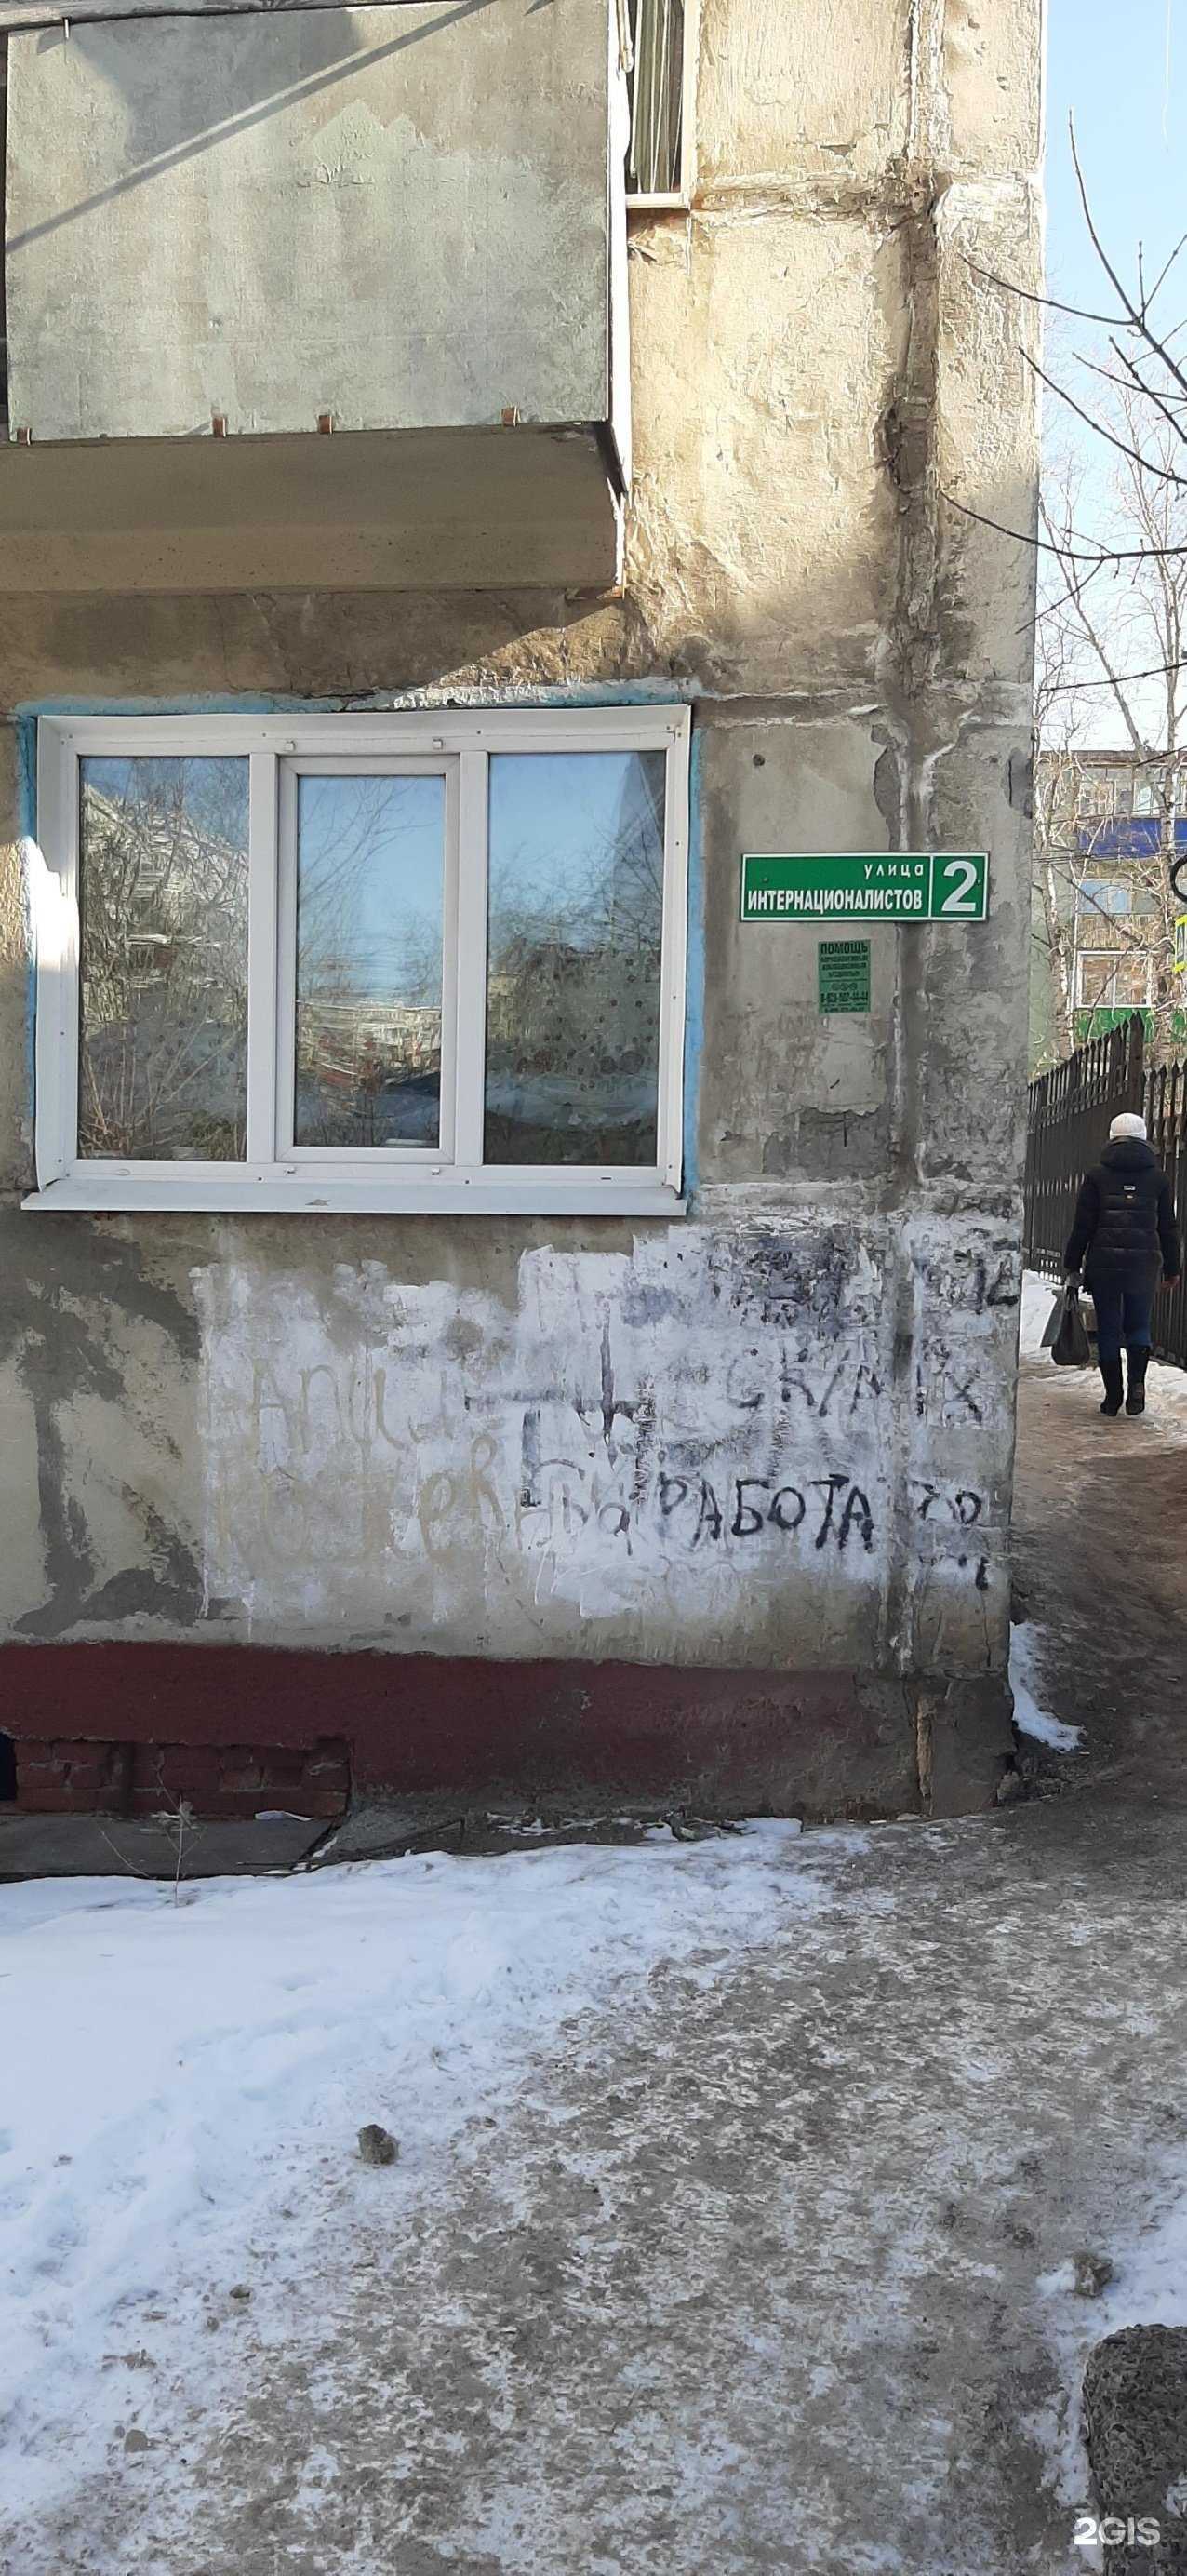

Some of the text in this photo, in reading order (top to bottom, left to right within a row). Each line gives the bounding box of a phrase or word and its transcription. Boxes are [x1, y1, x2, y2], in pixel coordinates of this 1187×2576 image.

[864, 863, 924, 879] улица
[941, 860, 978, 912] 2
[747, 889, 922, 914] ИНТЕРНАЦИОНАЛИСТОВ
[820, 941, 869, 954] ПОМОЩЬ
[659, 1472, 875, 1552] РАБОТА
